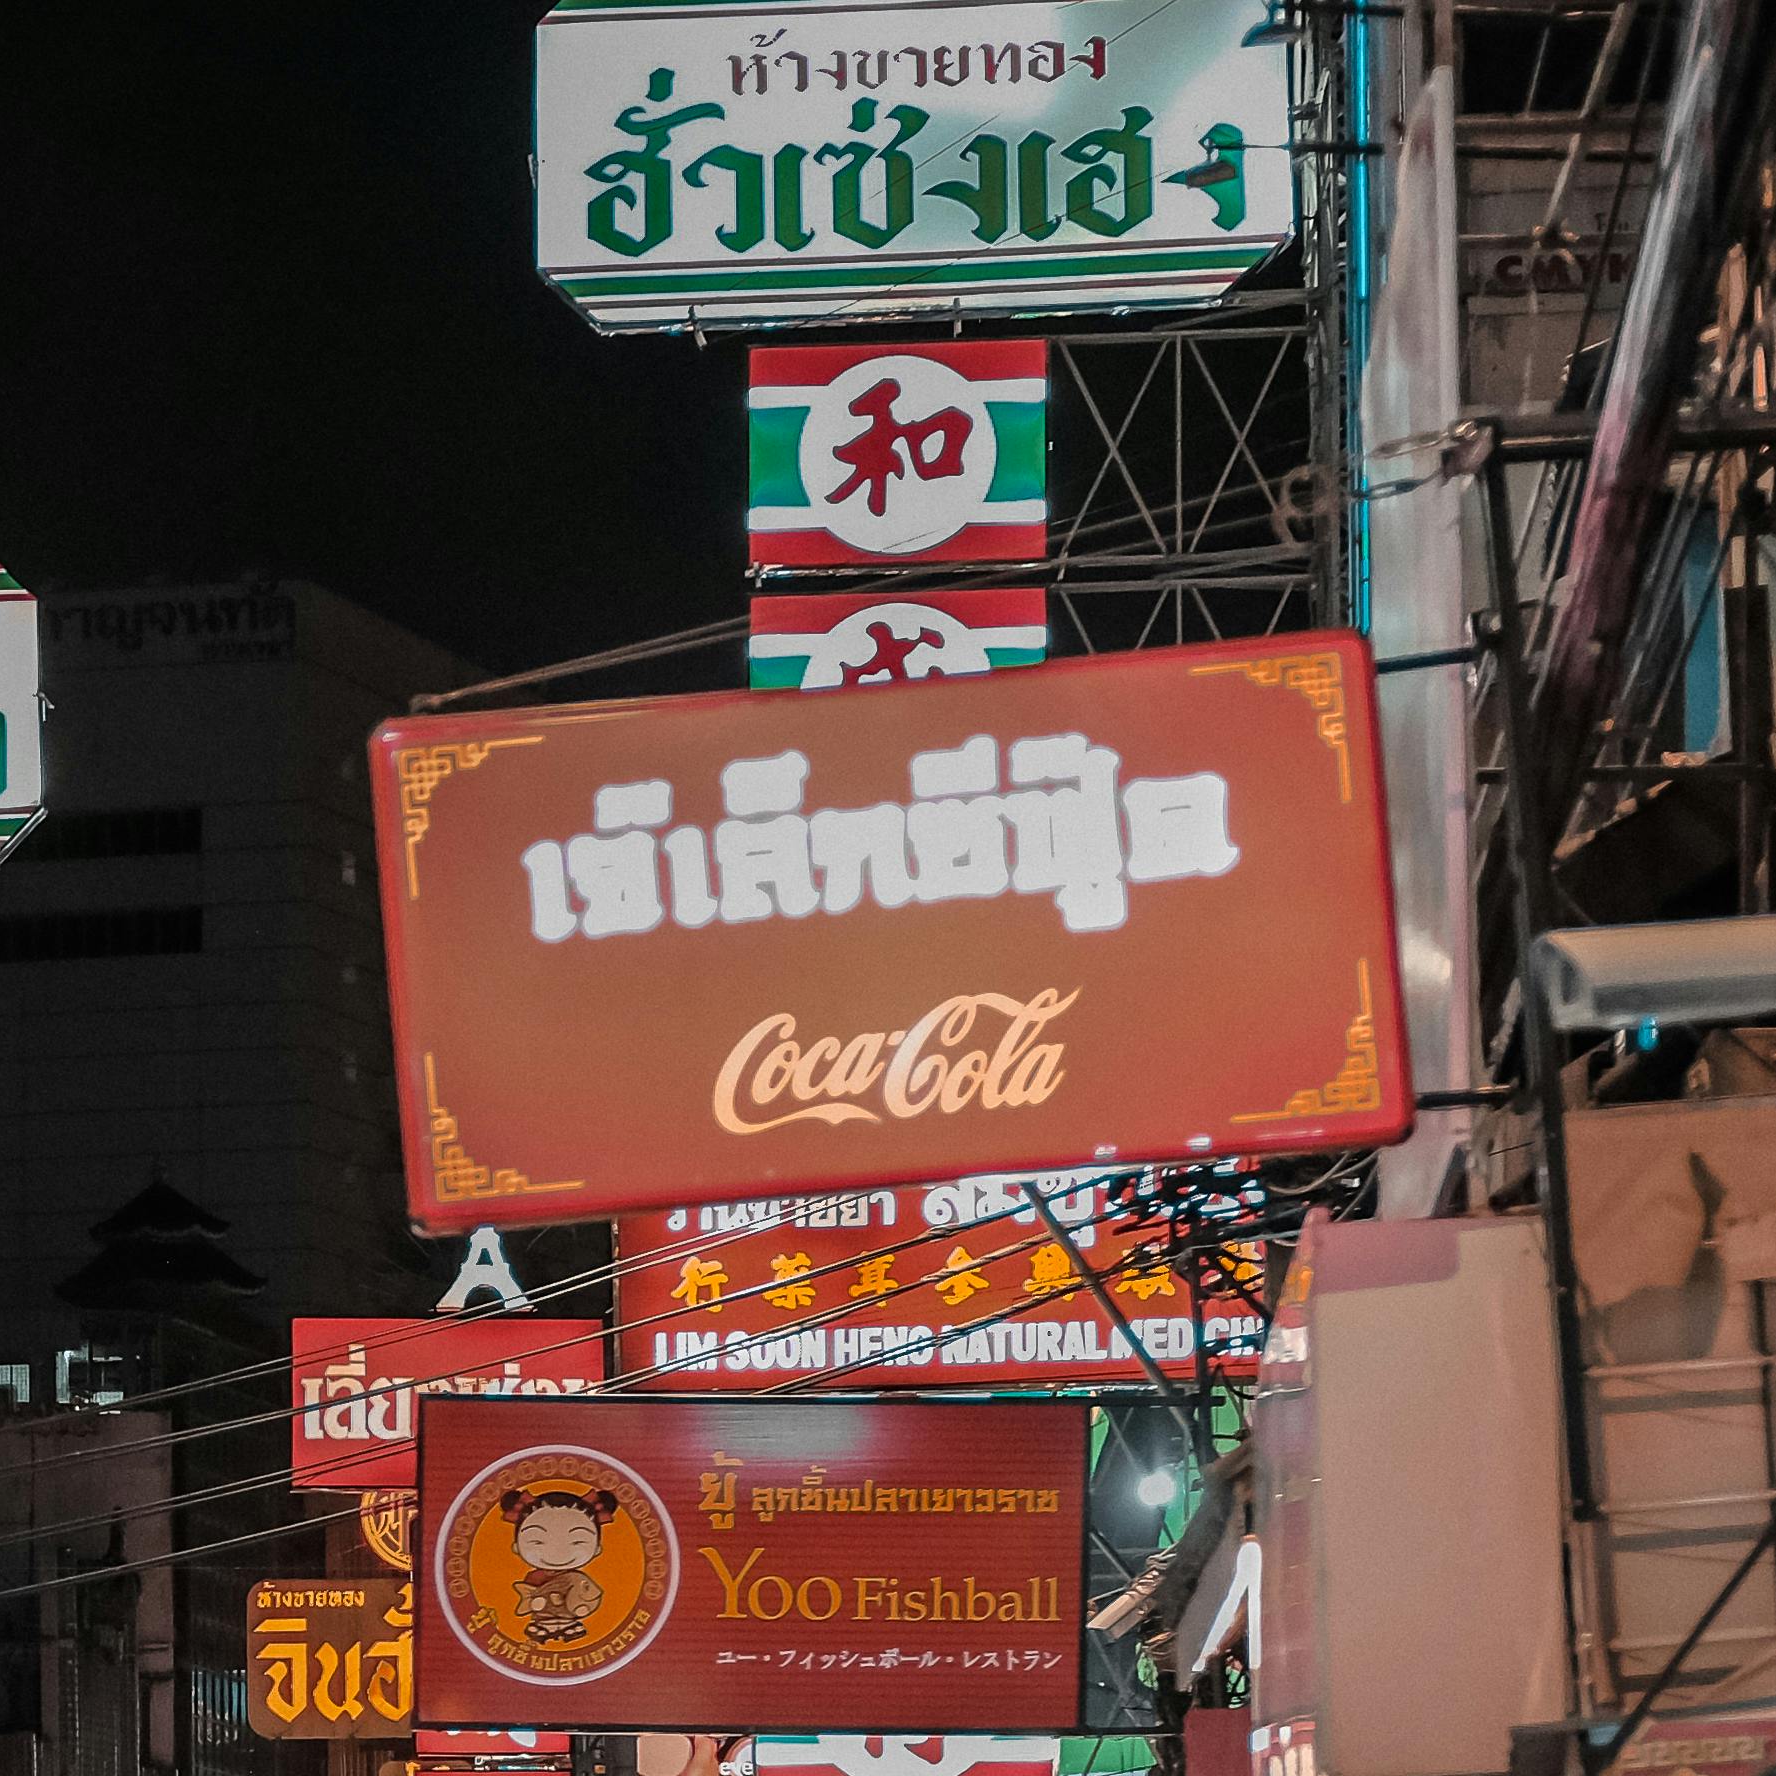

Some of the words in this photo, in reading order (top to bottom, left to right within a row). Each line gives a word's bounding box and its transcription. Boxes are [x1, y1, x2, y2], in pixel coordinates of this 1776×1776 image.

[726, 27, 1108, 97] ห้างขายทอง
[584, 67, 1246, 257] ฮั่วเซ่งเฮง
[713, 985, 1082, 1135] Coca-Cola
[655, 1331, 718, 1372] LIM
[941, 1321, 1108, 1364] NATURAL
[752, 1465, 1060, 1523] ลูกชิ้นปลาเยาวราช
[853, 1576, 1063, 1621] Fishball
